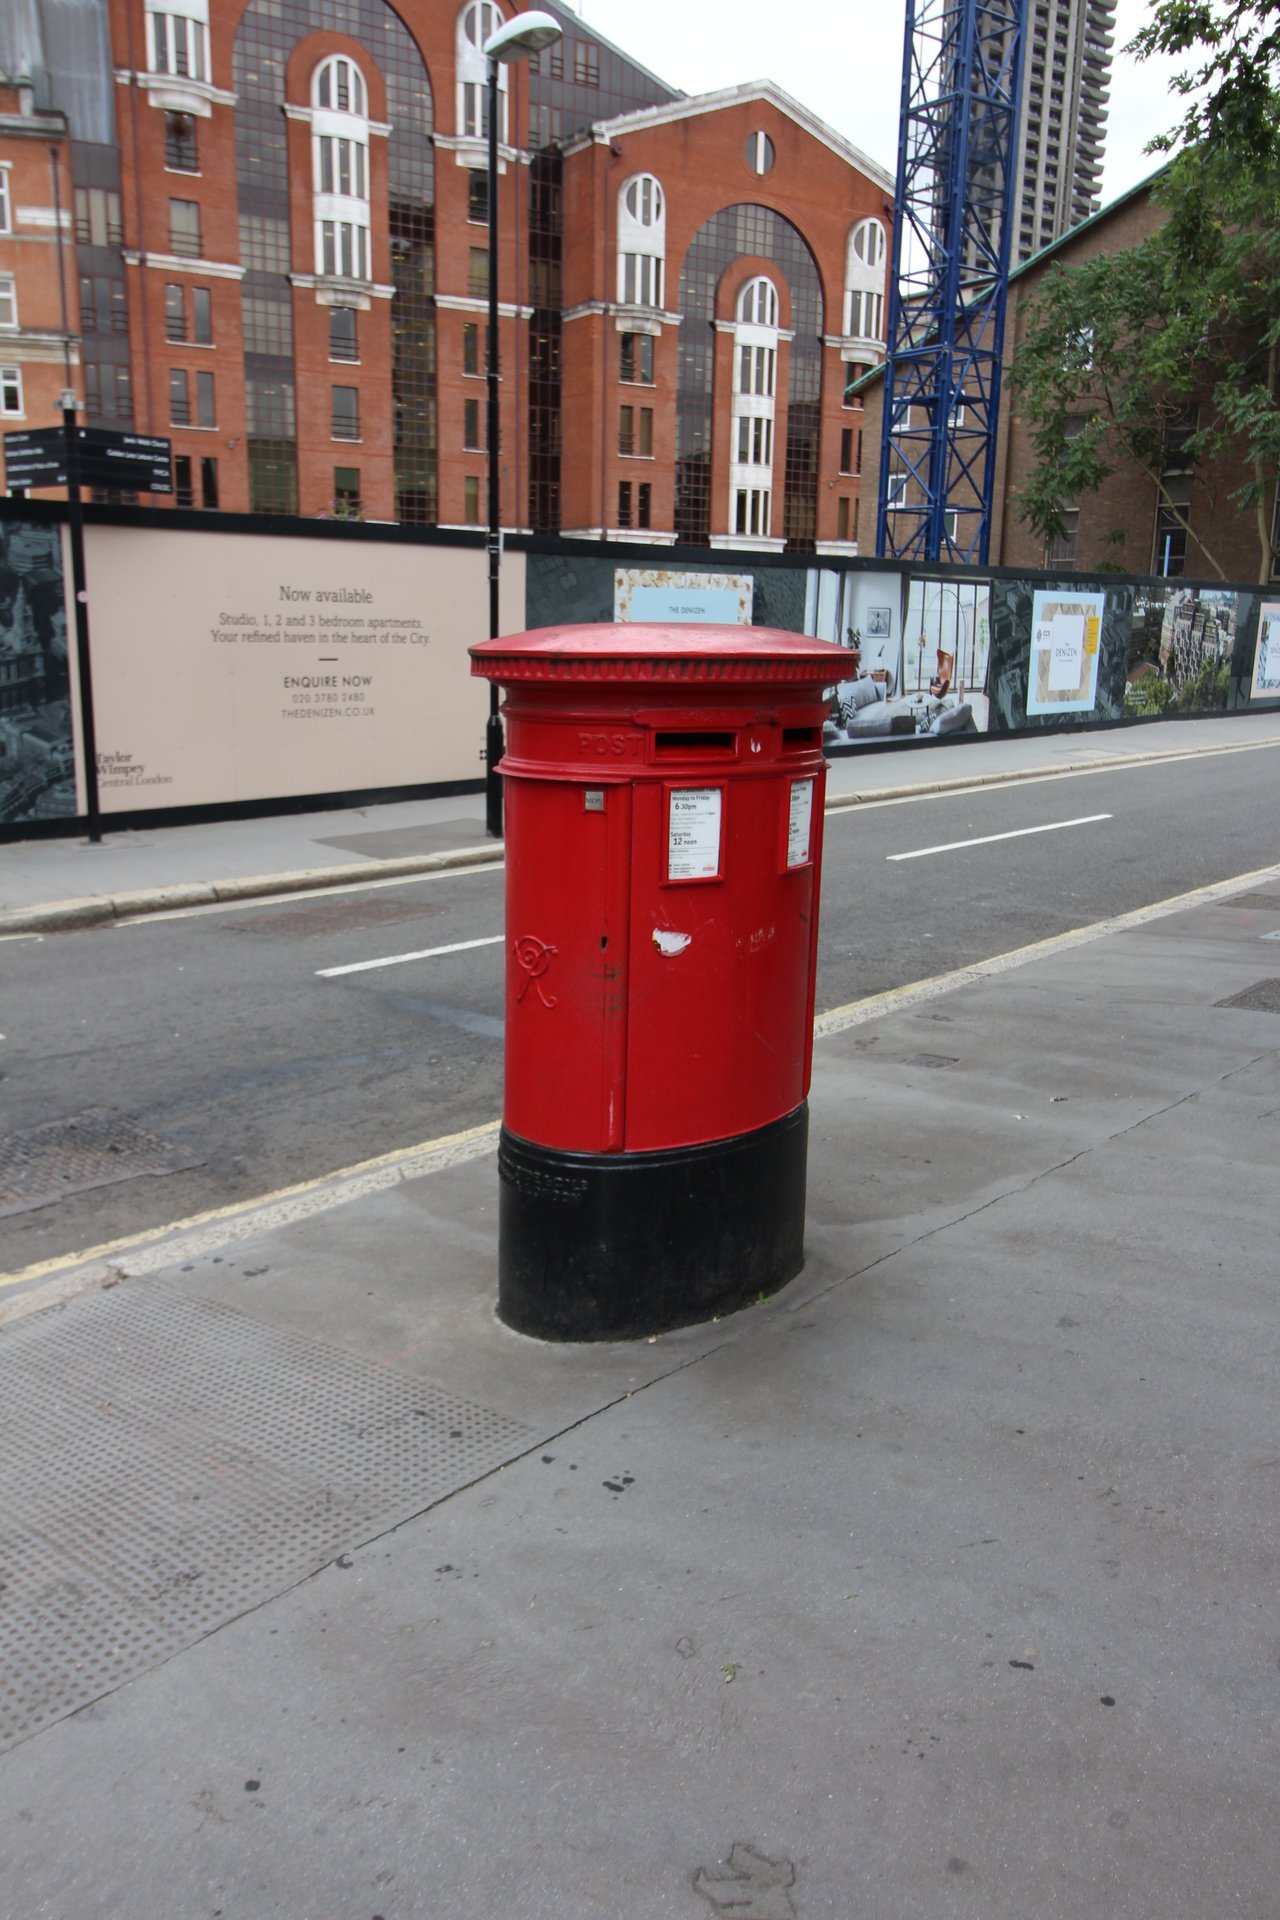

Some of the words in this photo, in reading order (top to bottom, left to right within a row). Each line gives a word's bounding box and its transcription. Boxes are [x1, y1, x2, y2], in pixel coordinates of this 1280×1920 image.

[279, 586, 312, 602] Now
[315, 588, 373, 604] available
[668, 606, 680, 614] THE
[219, 613, 260, 628] Studio,
[275, 614, 283, 627] 2
[285, 615, 306, 627] and
[309, 615, 316, 627] 3
[319, 616, 365, 628] bedroom
[210, 630, 239, 644] Your
[241, 630, 281, 644] refined
[283, 631, 316, 644] haven
[318, 631, 329, 644] in
[332, 631, 349, 644] the
[351, 631, 377, 645] heart
[379, 631, 391, 645] of
[392, 631, 407, 645] the
[283, 676, 337, 689] ENQUIRE
[342, 675, 373, 688] NOW
[292, 694, 314, 704] 020
[578, 732, 644, 757] POST
[672, 838, 683, 846] 12
